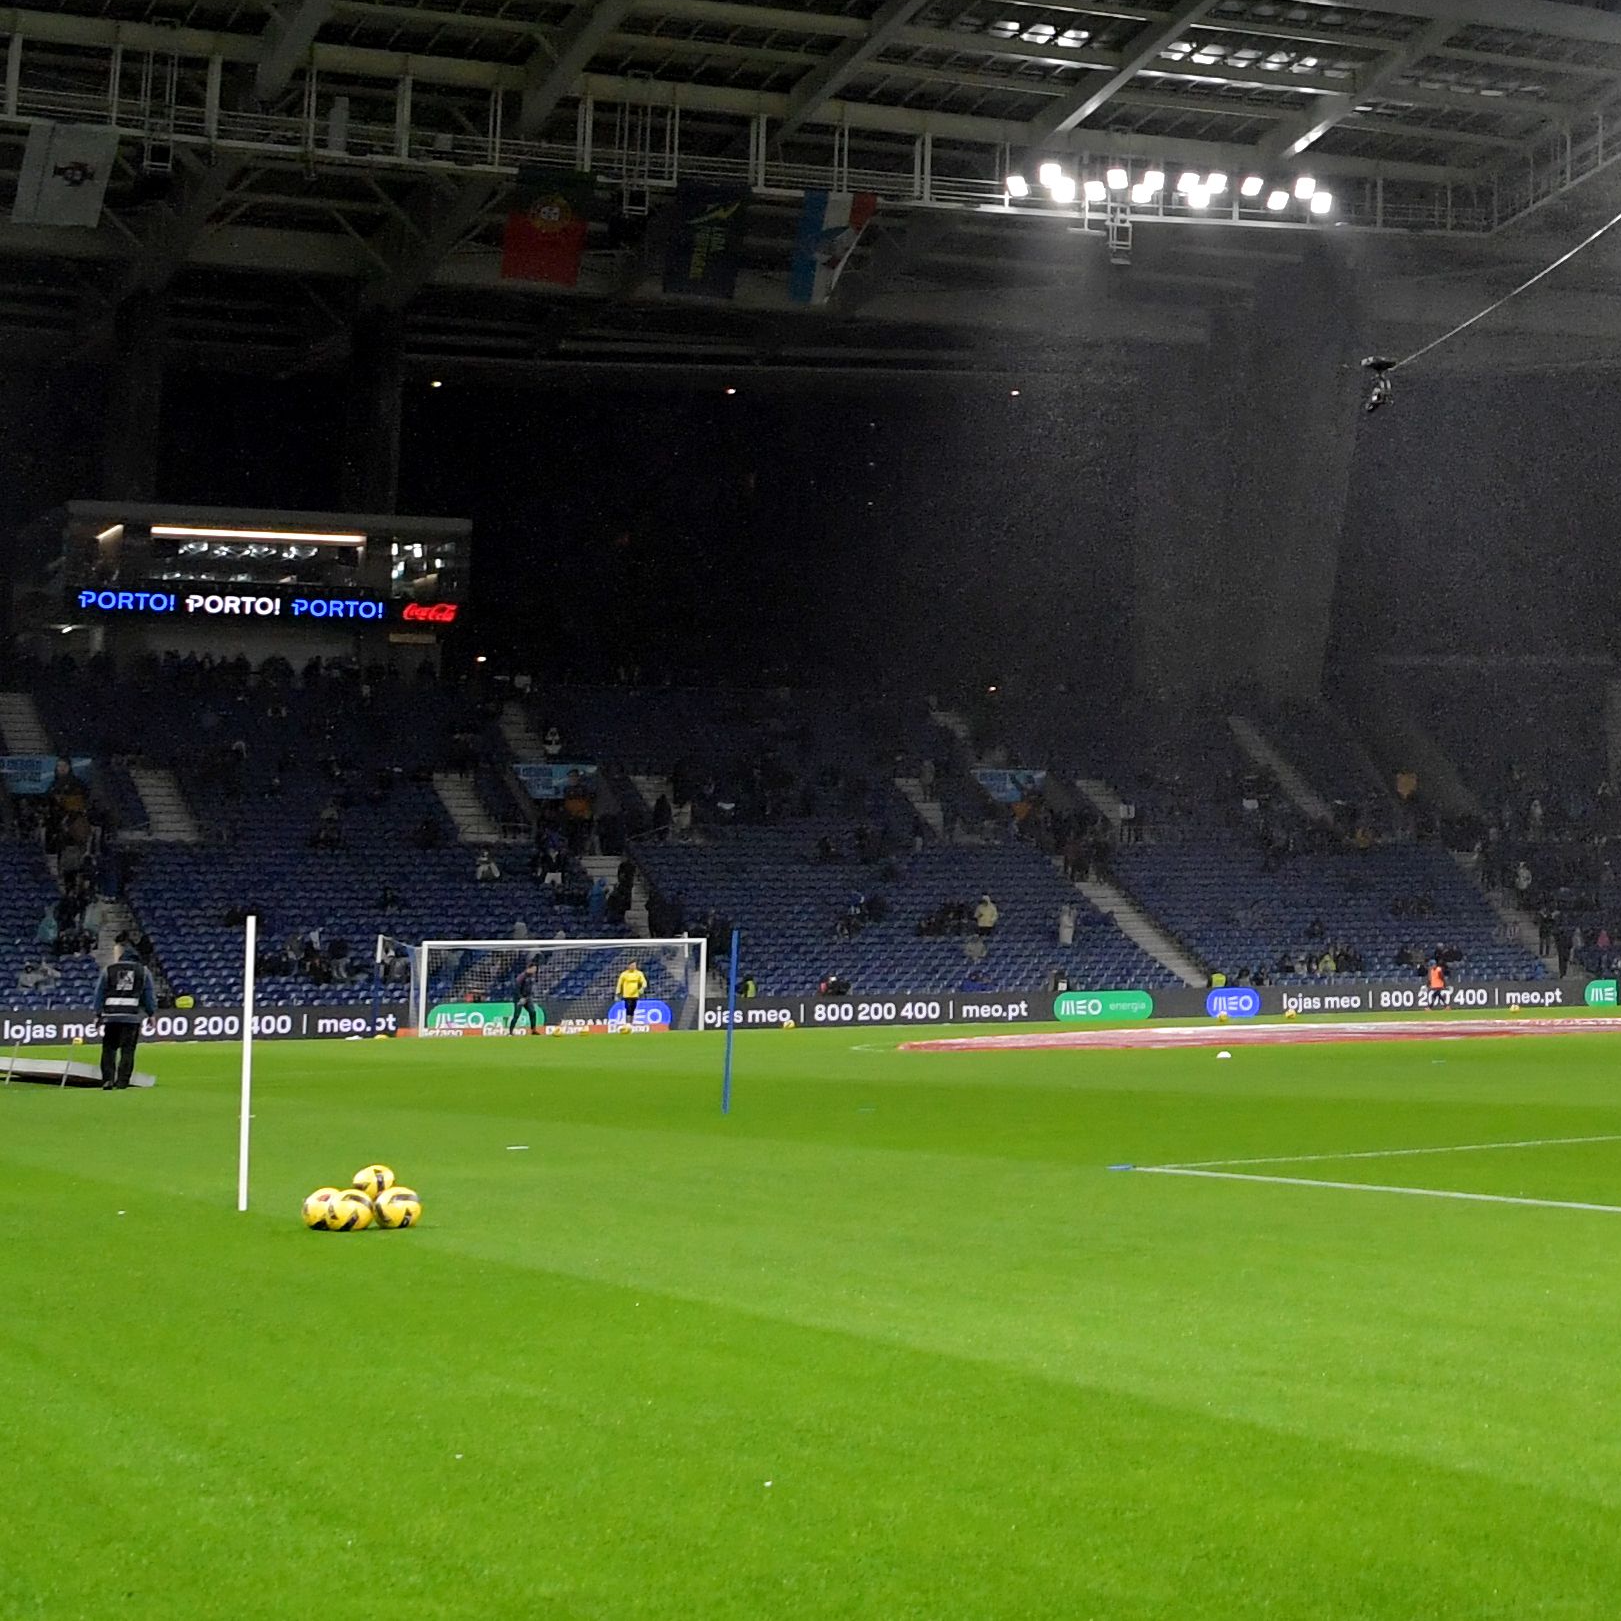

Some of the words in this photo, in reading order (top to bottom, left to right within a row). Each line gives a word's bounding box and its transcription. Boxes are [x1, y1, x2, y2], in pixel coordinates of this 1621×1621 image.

[78, 591, 175, 611] PORTO!
[186, 595, 280, 616] PORTO!
[292, 599, 384, 619] PORTO!
[748, 1007, 791, 1023] meo
[814, 1003, 853, 1021] 800
[858, 1002, 896, 1021] 200
[900, 1002, 940, 1020] 400
[963, 1000, 1028, 1022] meo.pt
[1061, 999, 1102, 1016] MEO
[1213, 995, 1253, 1011] MEO
[1283, 993, 1321, 1012] lojas
[1325, 994, 1361, 1009] meo
[1380, 990, 1413, 1007] 800
[1454, 989, 1487, 1005] 400
[1506, 988, 1562, 1007] meo.pt
[3, 1019, 57, 1044] lojas
[193, 1015, 239, 1035] 200
